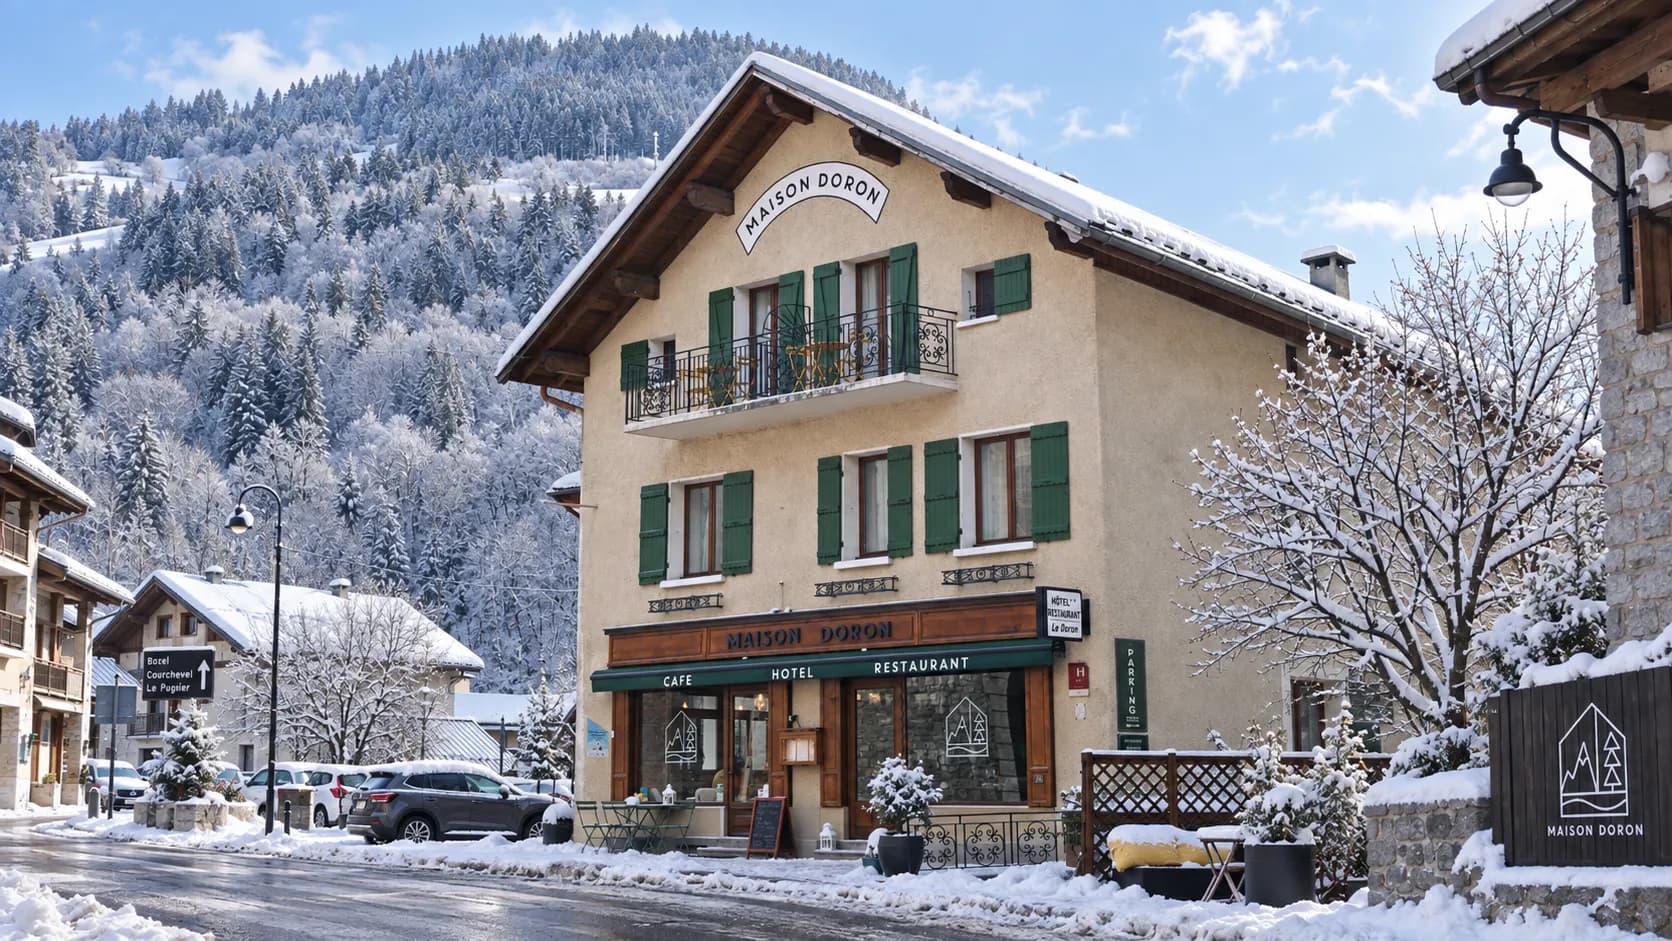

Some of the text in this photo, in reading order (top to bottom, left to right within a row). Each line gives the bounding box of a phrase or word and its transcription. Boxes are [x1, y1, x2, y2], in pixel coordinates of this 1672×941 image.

[745, 173, 881, 235] MAISON DORON
[727, 621, 892, 649] MAISON DORON
[874, 657, 969, 674] RESTAURANT
[1076, 666, 1085, 678] H
[146, 669, 193, 679] Courchevel
[771, 666, 814, 680] HOTEL
[663, 674, 693, 687] CAFE
[1127, 648, 1136, 715] PARKING
[146, 684, 157, 692] Le
[1547, 823, 1644, 837] MAISON DORON
